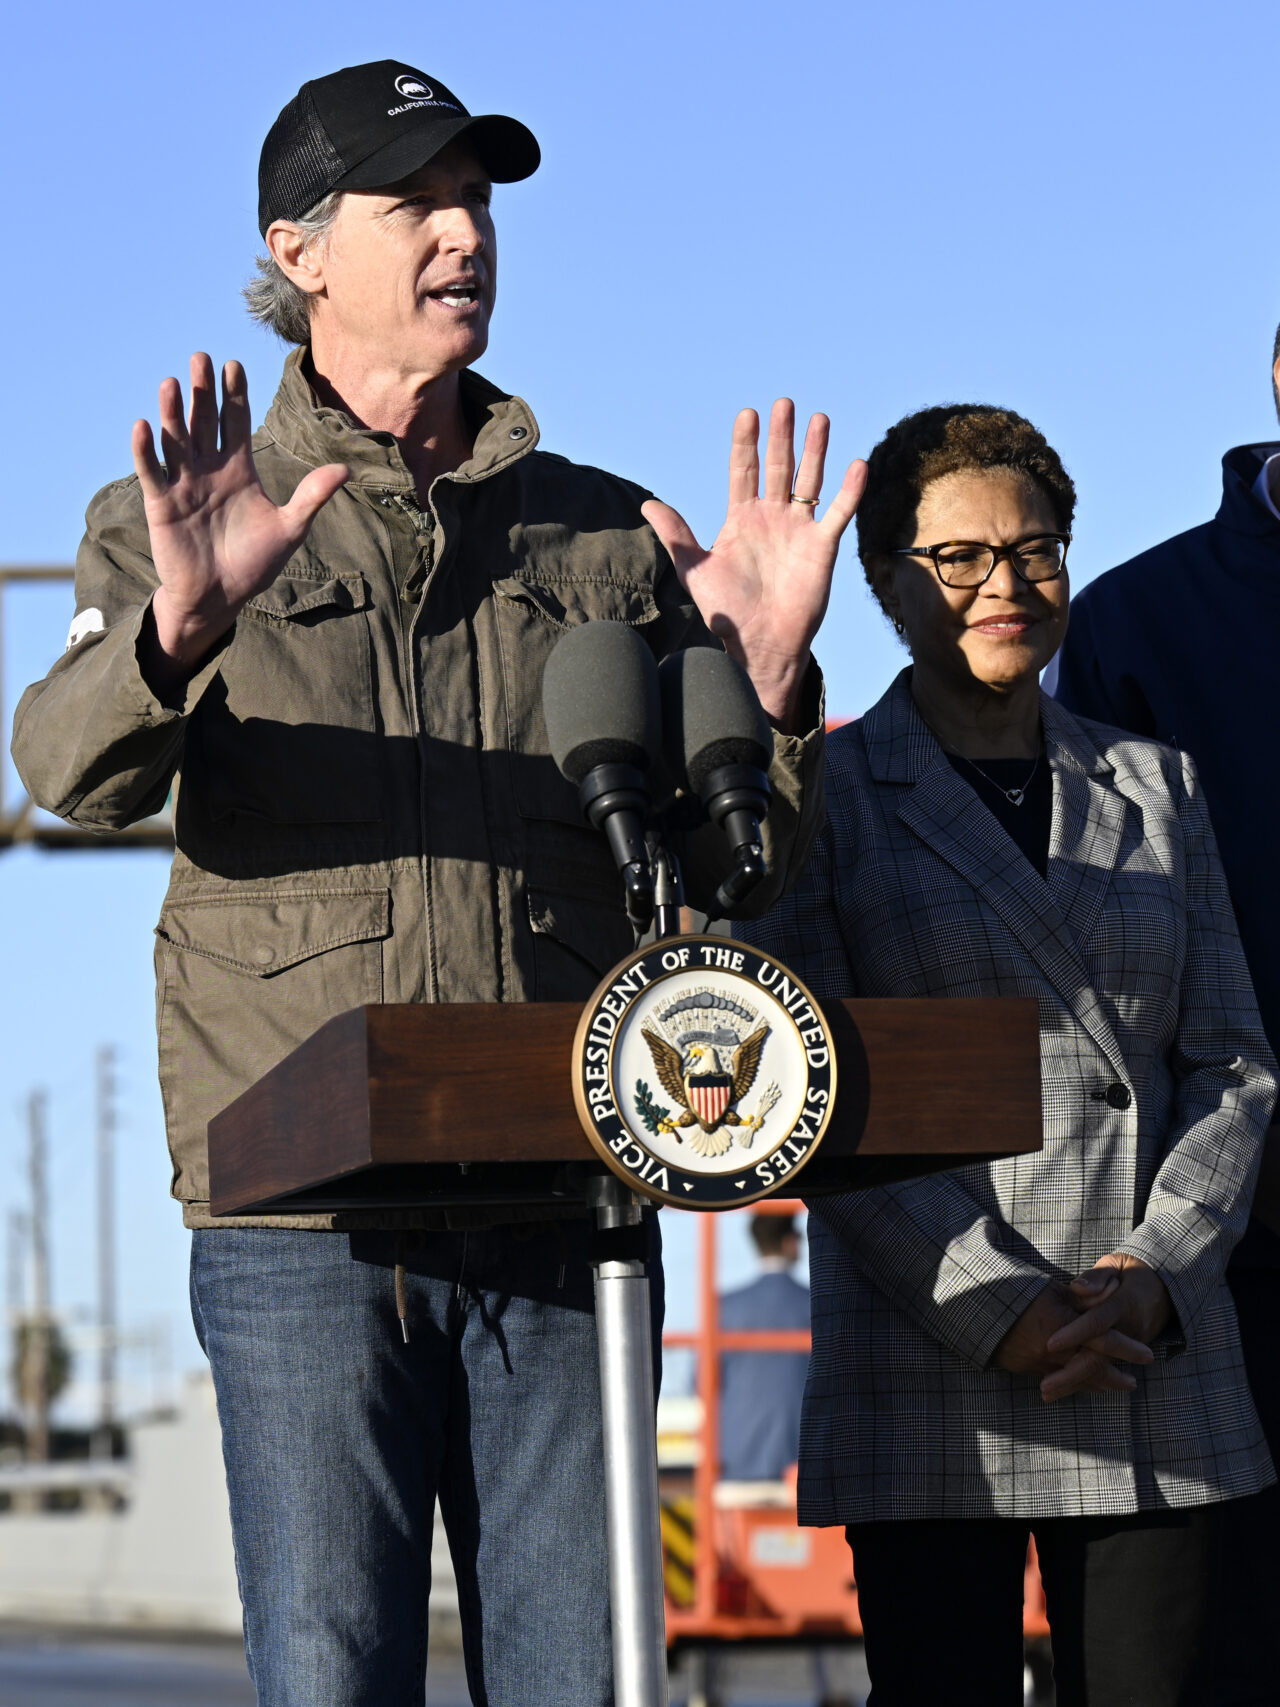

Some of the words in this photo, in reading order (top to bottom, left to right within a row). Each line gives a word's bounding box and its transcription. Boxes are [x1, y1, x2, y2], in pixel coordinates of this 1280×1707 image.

[387, 100, 440, 116] CALIFORNIA
[661, 948, 690, 971] OF
[700, 946, 745, 972] THE
[586, 961, 651, 1122] PRESIDENT
[757, 962, 829, 1068] UNITED
[609, 1130, 670, 1192] VICE
[755, 1086, 829, 1187] STATES
